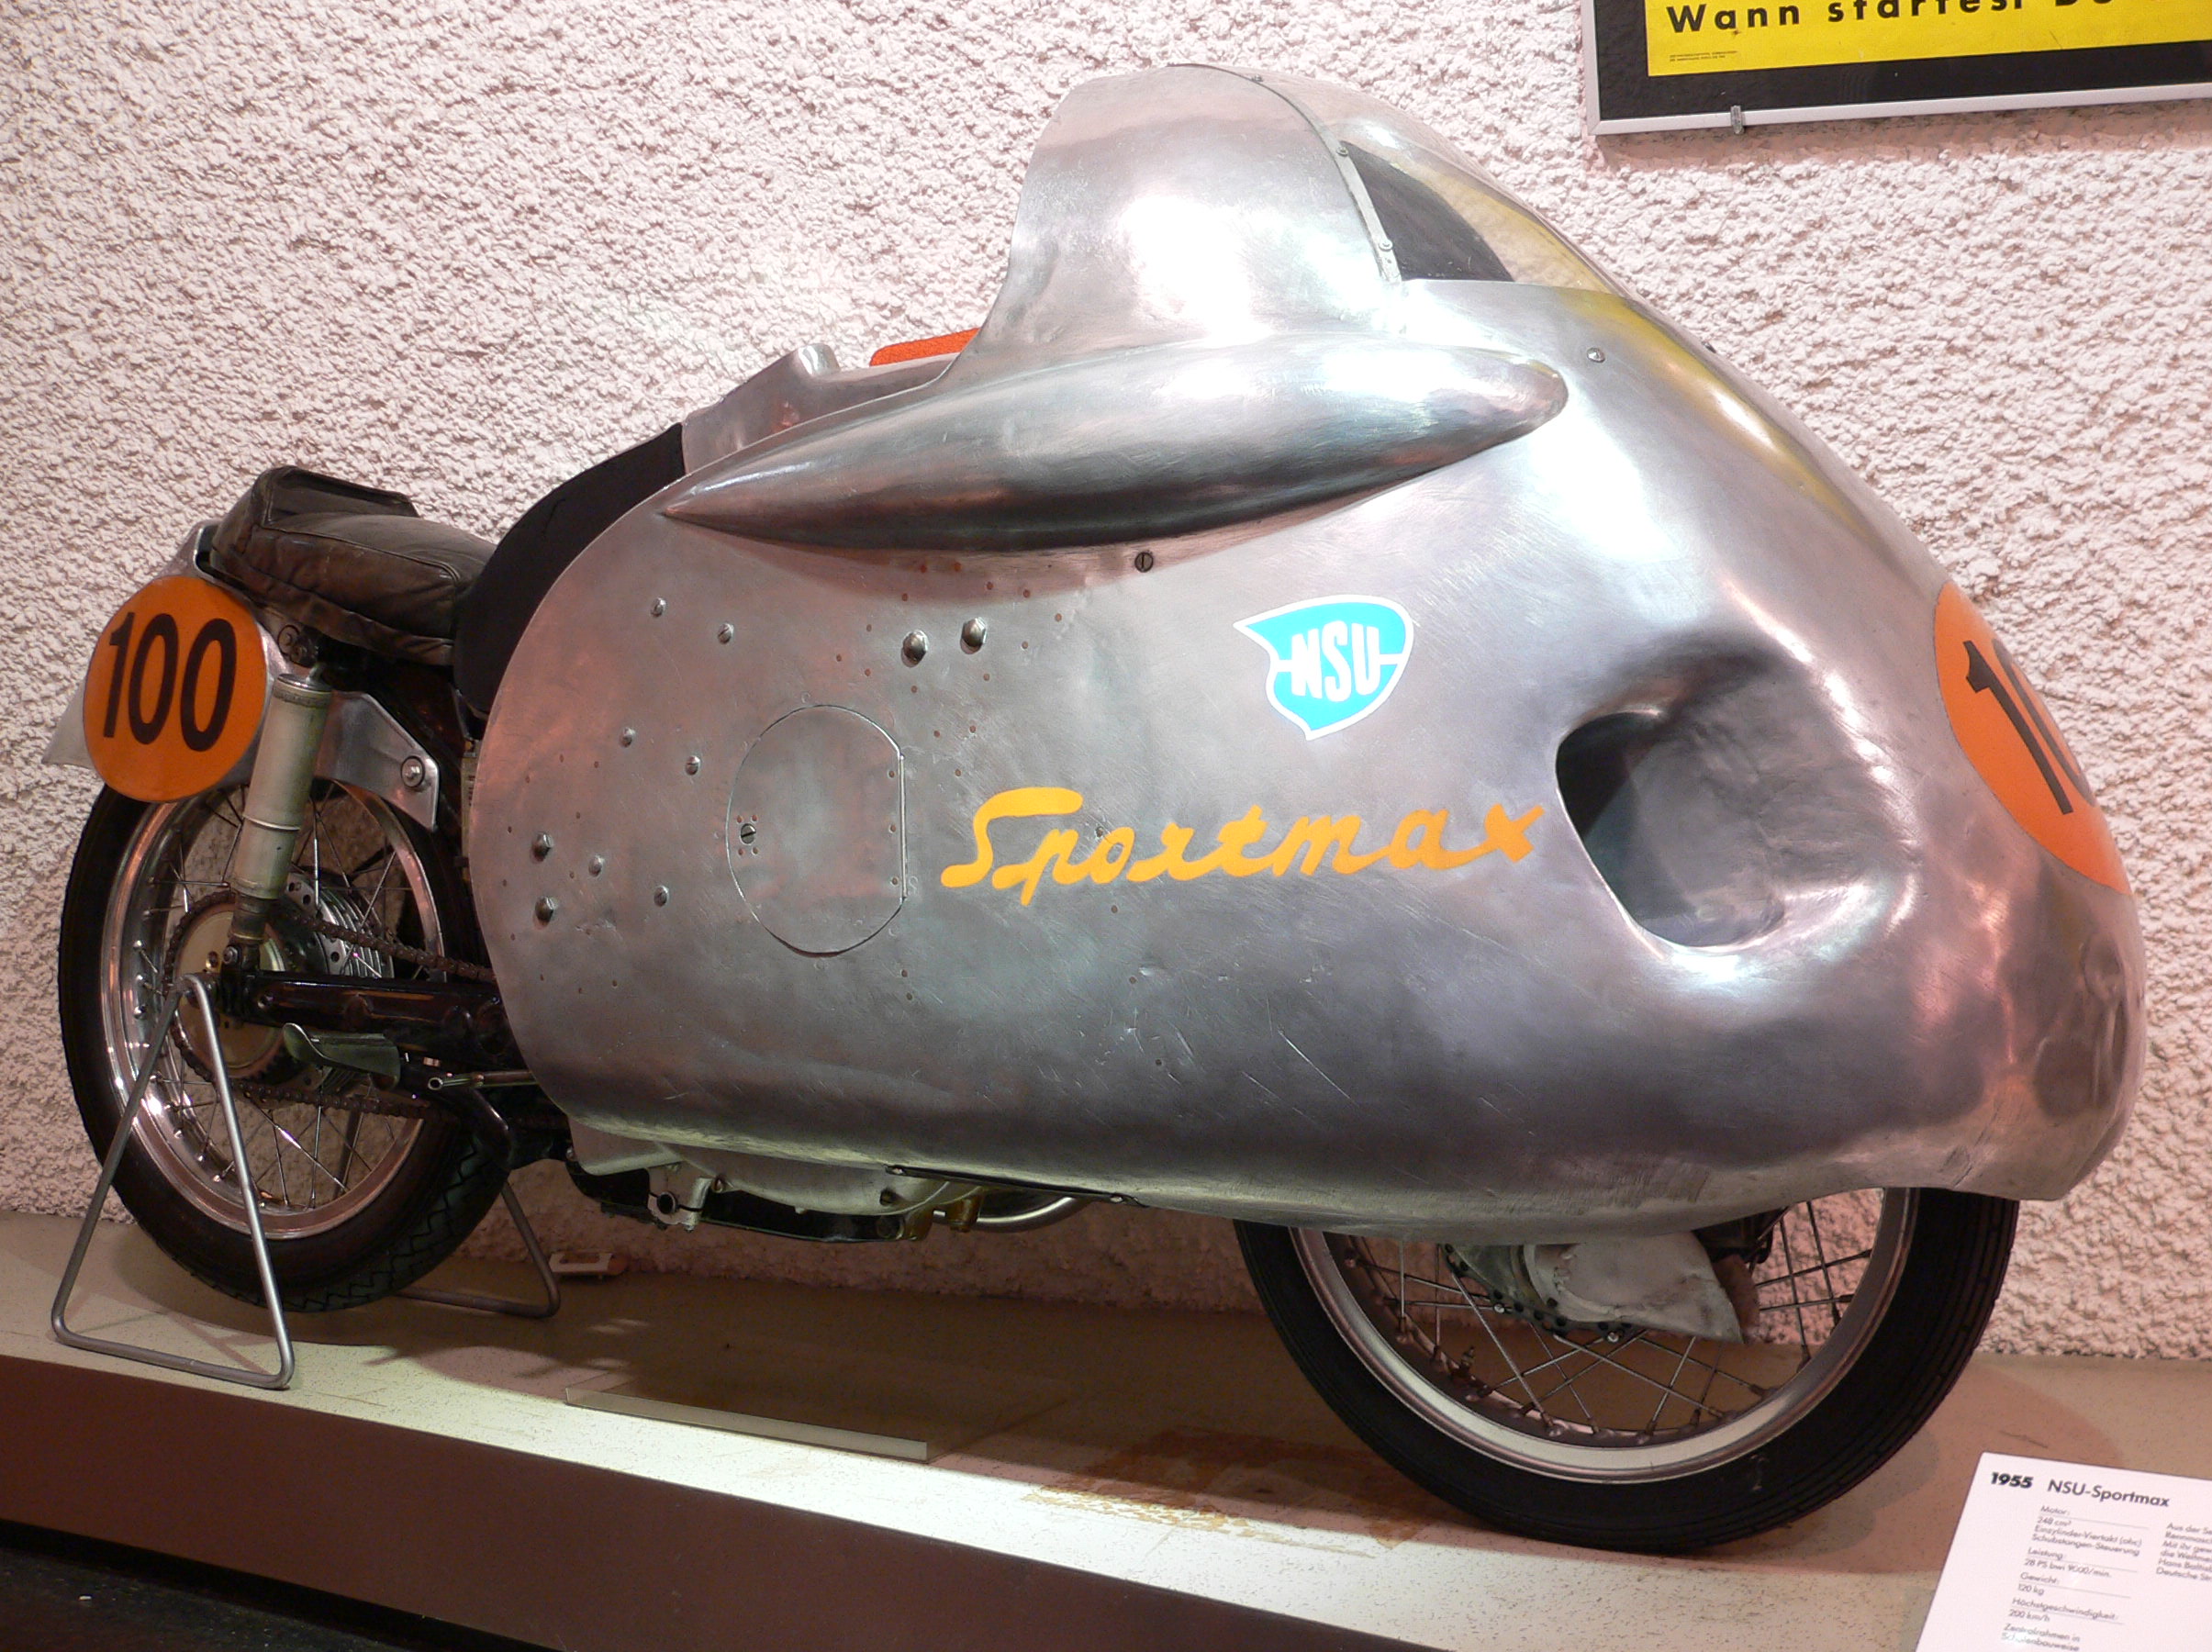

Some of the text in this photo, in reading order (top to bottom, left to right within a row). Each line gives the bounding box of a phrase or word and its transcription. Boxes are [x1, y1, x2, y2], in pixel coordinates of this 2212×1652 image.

[1667, 3, 1800, 33] Wann
[1291, 620, 1378, 703] NSU
[104, 612, 237, 752] 100
[941, 787, 1545, 906] Sportmax
[1991, 1471, 2171, 1508] 1955 NSU-Sportmax
[2017, 1583, 2032, 1593] 120
[2008, 1609, 2025, 1619] 200
